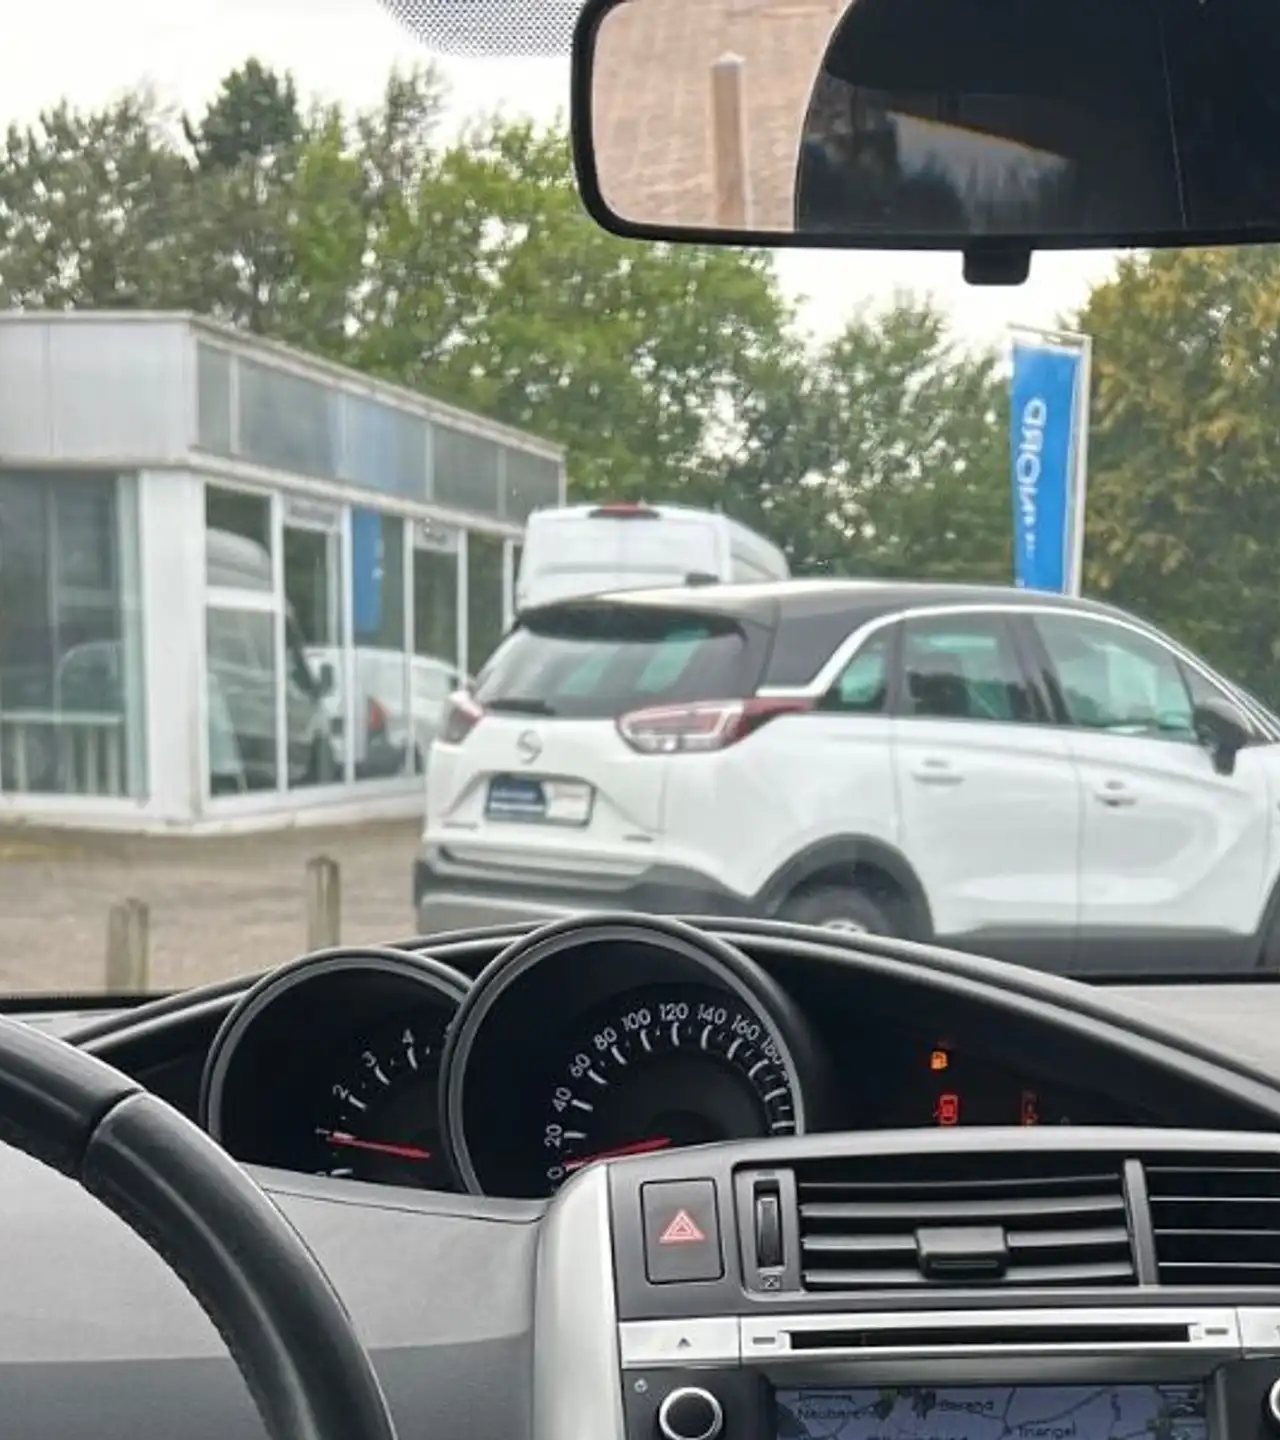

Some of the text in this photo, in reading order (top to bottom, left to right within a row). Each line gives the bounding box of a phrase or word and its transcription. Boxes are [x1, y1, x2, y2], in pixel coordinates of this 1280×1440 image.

[621, 1008, 652, 1031] 100
[659, 1002, 689, 1022] 120
[697, 1003, 727, 1026] 140
[592, 1027, 618, 1051] 80
[730, 1013, 760, 1042] 160
[332, 1083, 349, 1100] 2
[361, 1050, 377, 1068] 3
[402, 1028, 414, 1045] 4
[570, 1053, 591, 1078] 60
[552, 1086, 572, 1113] 40
[543, 1123, 563, 1149] 20
[546, 1165, 564, 1181] 0
